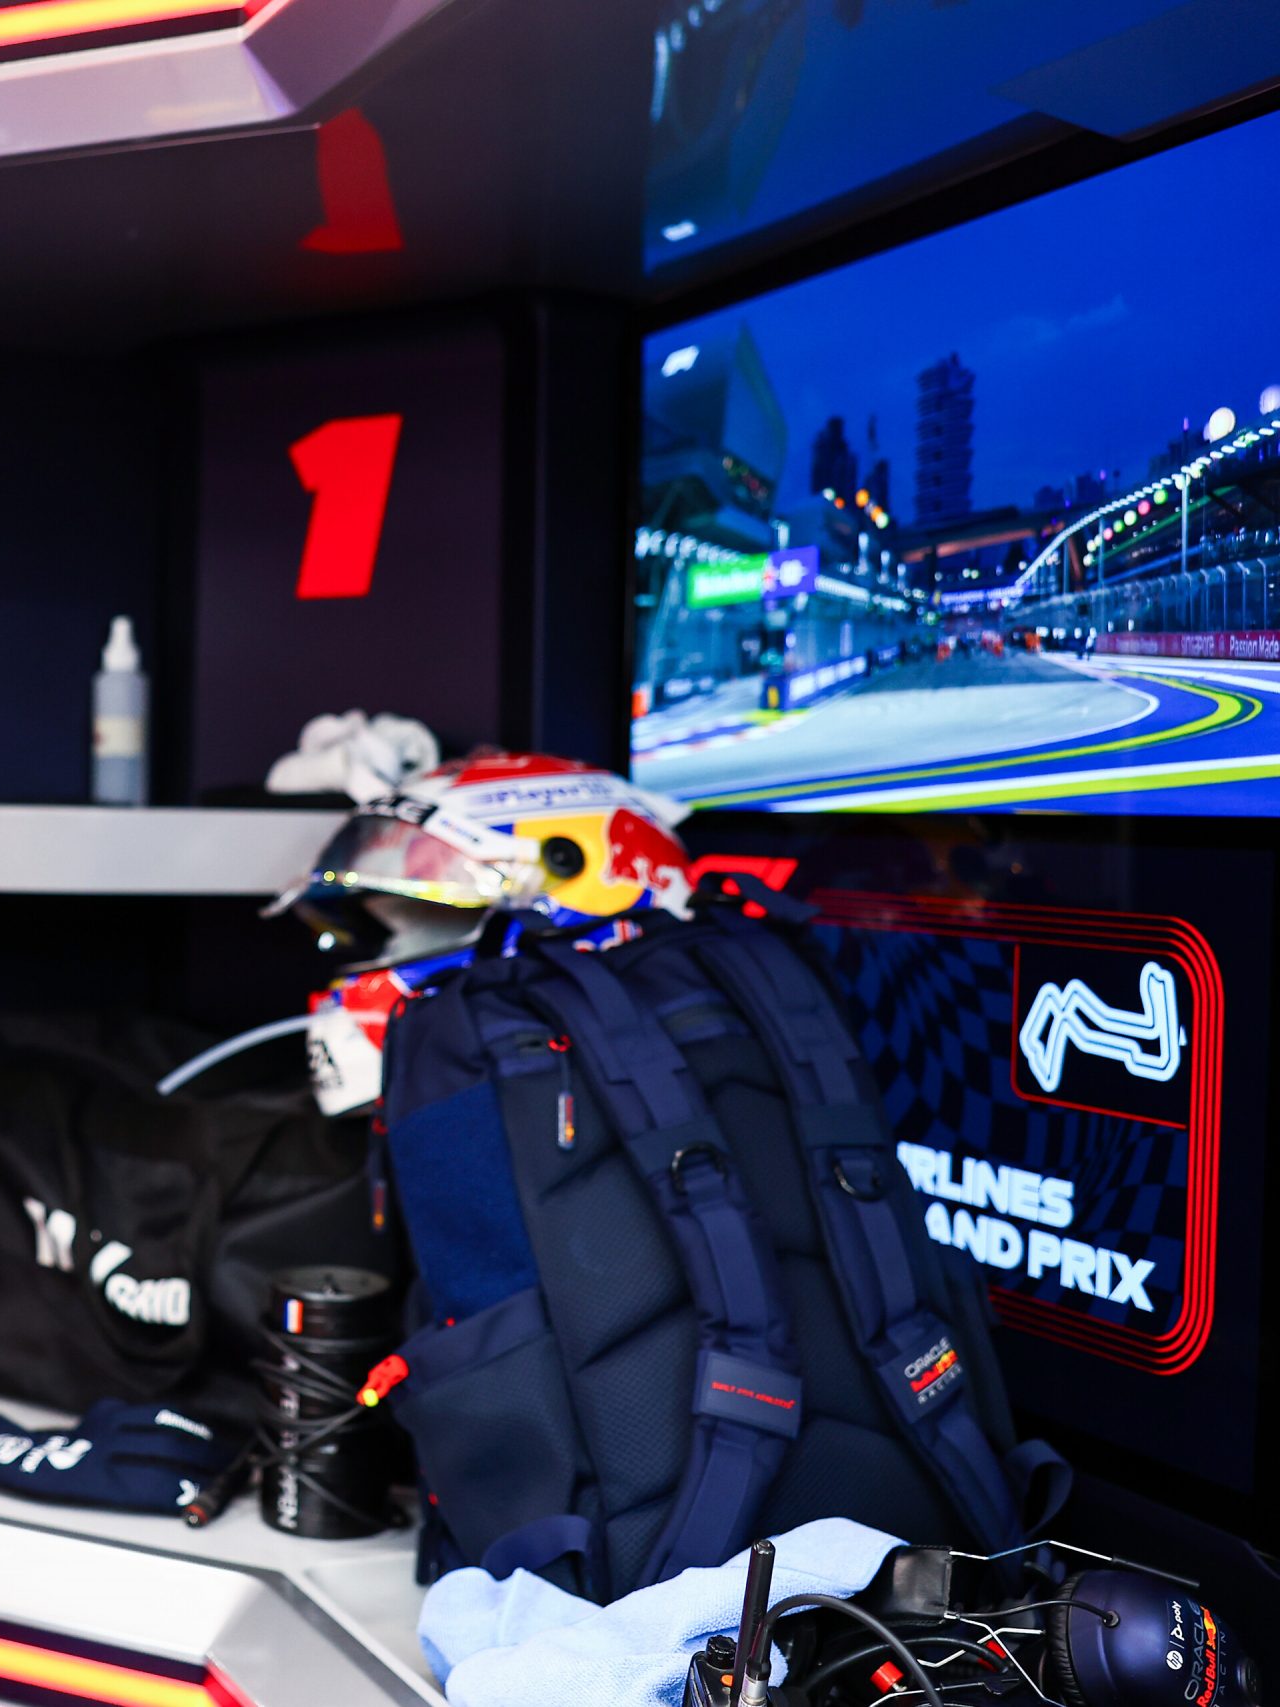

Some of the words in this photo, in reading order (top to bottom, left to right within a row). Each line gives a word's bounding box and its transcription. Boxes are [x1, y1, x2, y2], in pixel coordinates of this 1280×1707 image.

[288, 413, 404, 600] 1
[1229, 634, 1257, 657] Passion
[1258, 634, 1279, 658] Made
[924, 1201, 1024, 1270] AND
[1027, 1229, 1157, 1312] PRIX
[1184, 1599, 1204, 1700] ORACLE
[1205, 1649, 1217, 1681] Bull
